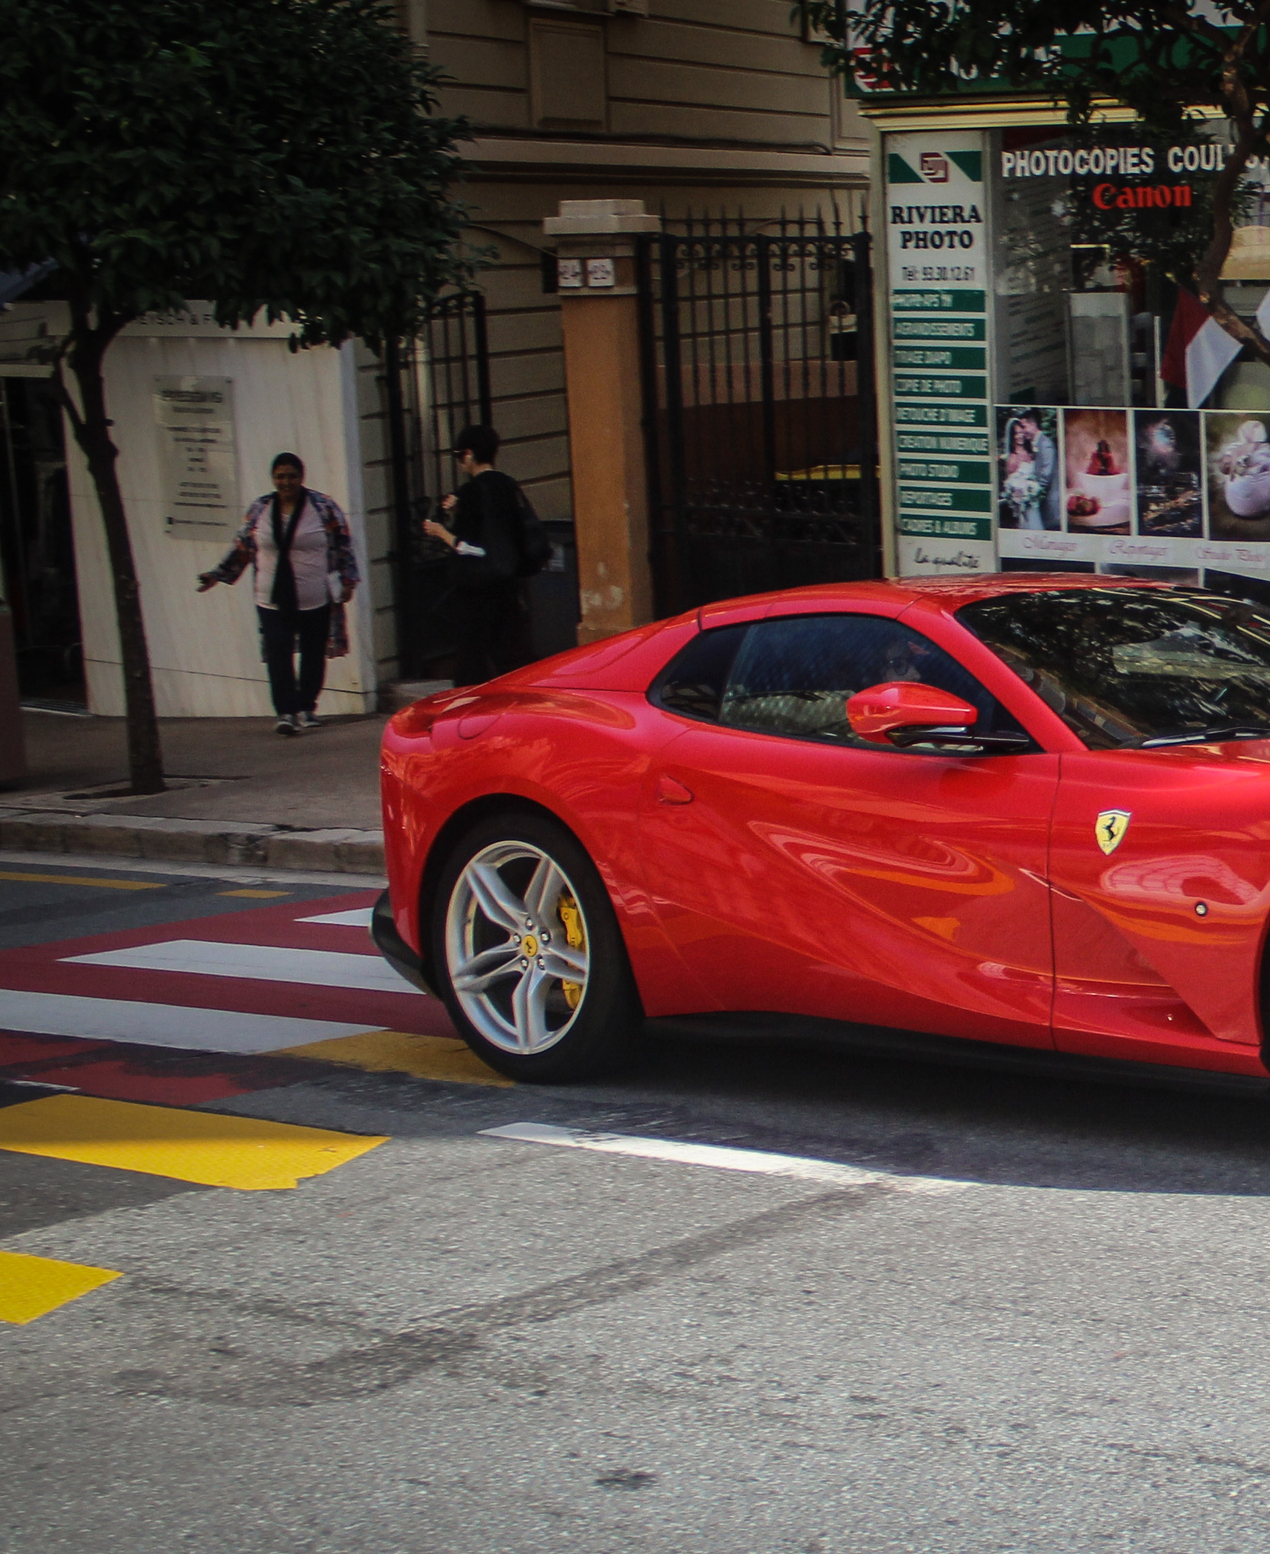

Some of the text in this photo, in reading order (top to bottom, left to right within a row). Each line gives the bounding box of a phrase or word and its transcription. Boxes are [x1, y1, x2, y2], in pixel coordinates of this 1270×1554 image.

[1001, 146, 1155, 178] PHOTOCOPIES
[1092, 182, 1193, 210] Canon
[890, 204, 983, 224] RIVIERA
[900, 230, 973, 249] PHOTO
[933, 379, 962, 394] PHOTO
